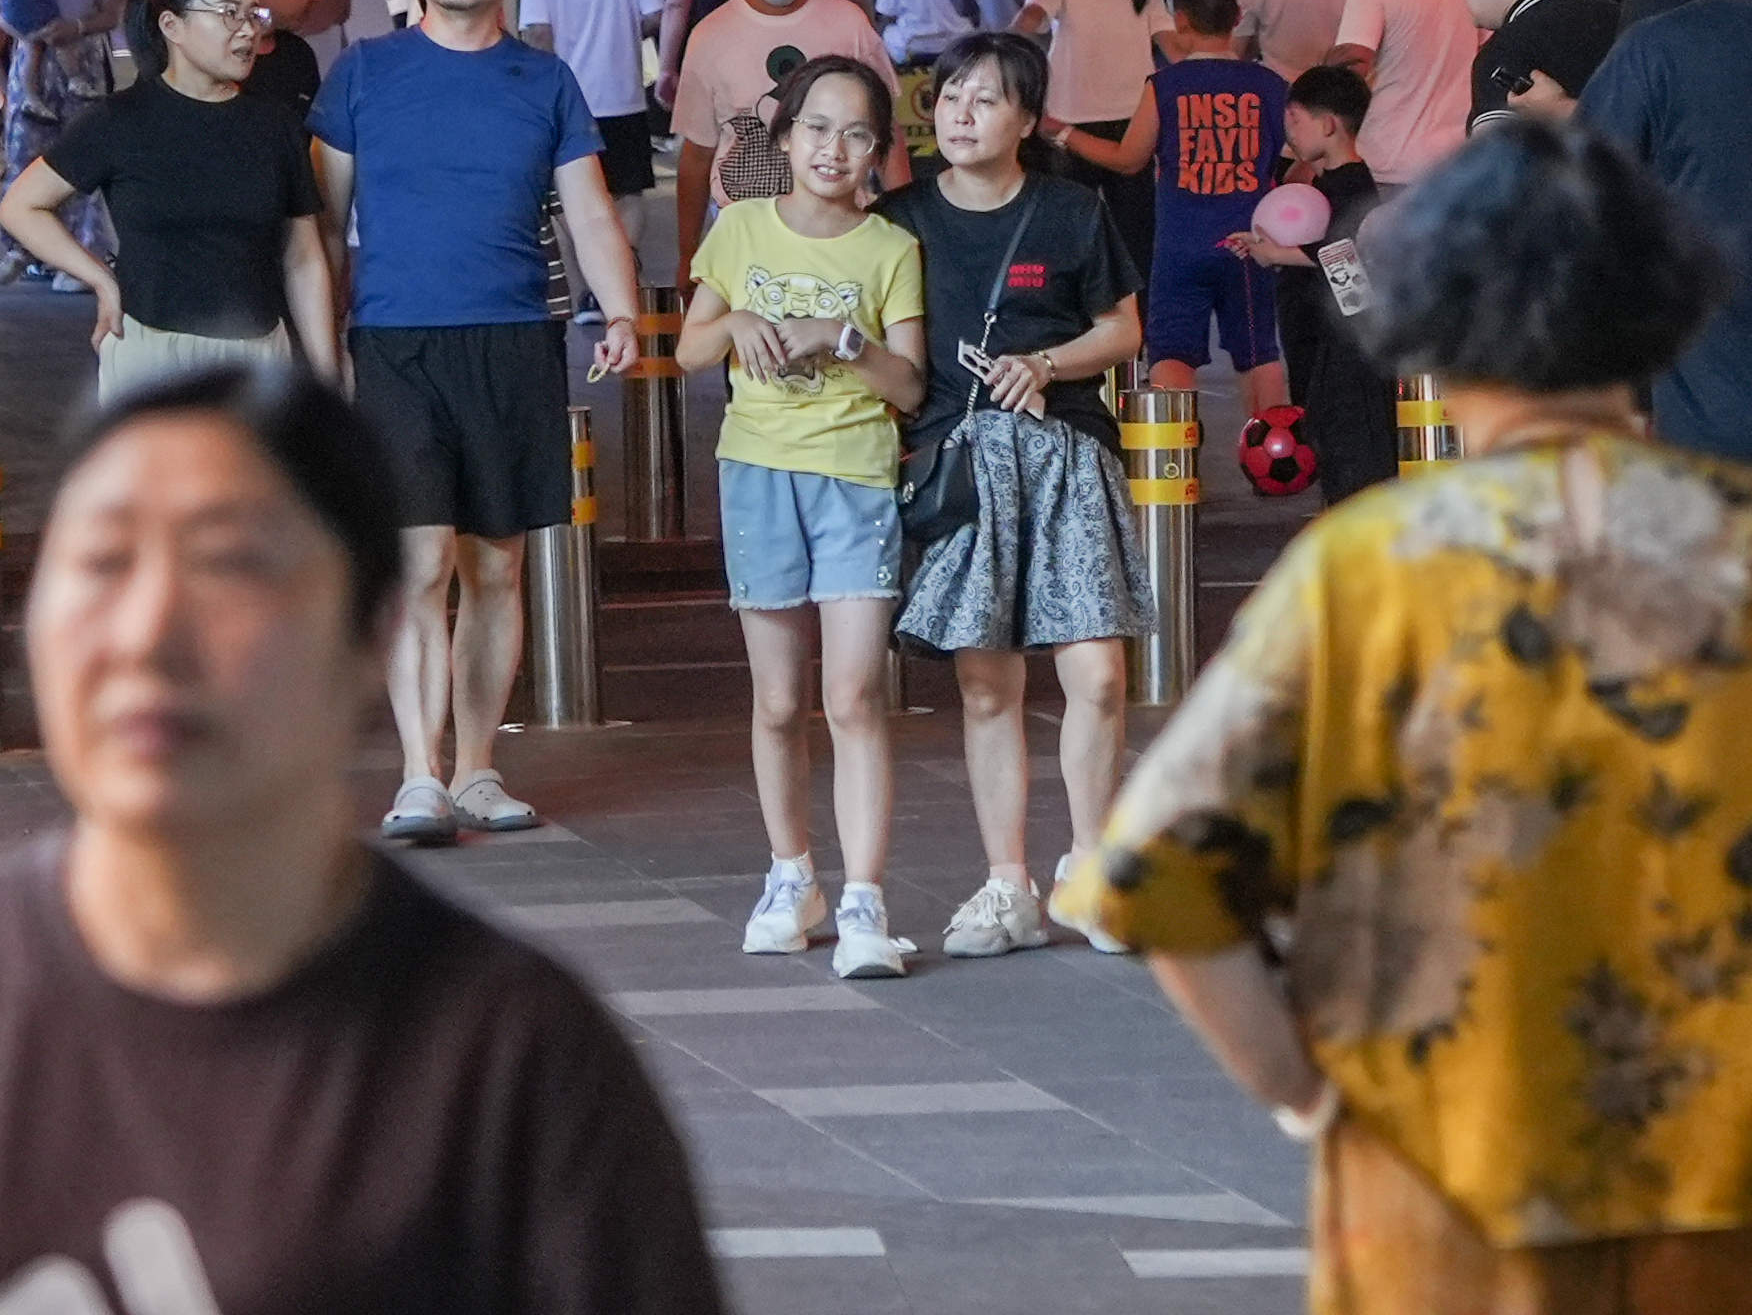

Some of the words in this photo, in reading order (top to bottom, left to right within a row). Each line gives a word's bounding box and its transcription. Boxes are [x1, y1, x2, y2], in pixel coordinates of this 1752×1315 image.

[1176, 93, 1261, 129] INSG
[1178, 128, 1260, 164] FAYU
[1178, 161, 1260, 195] KIDS
